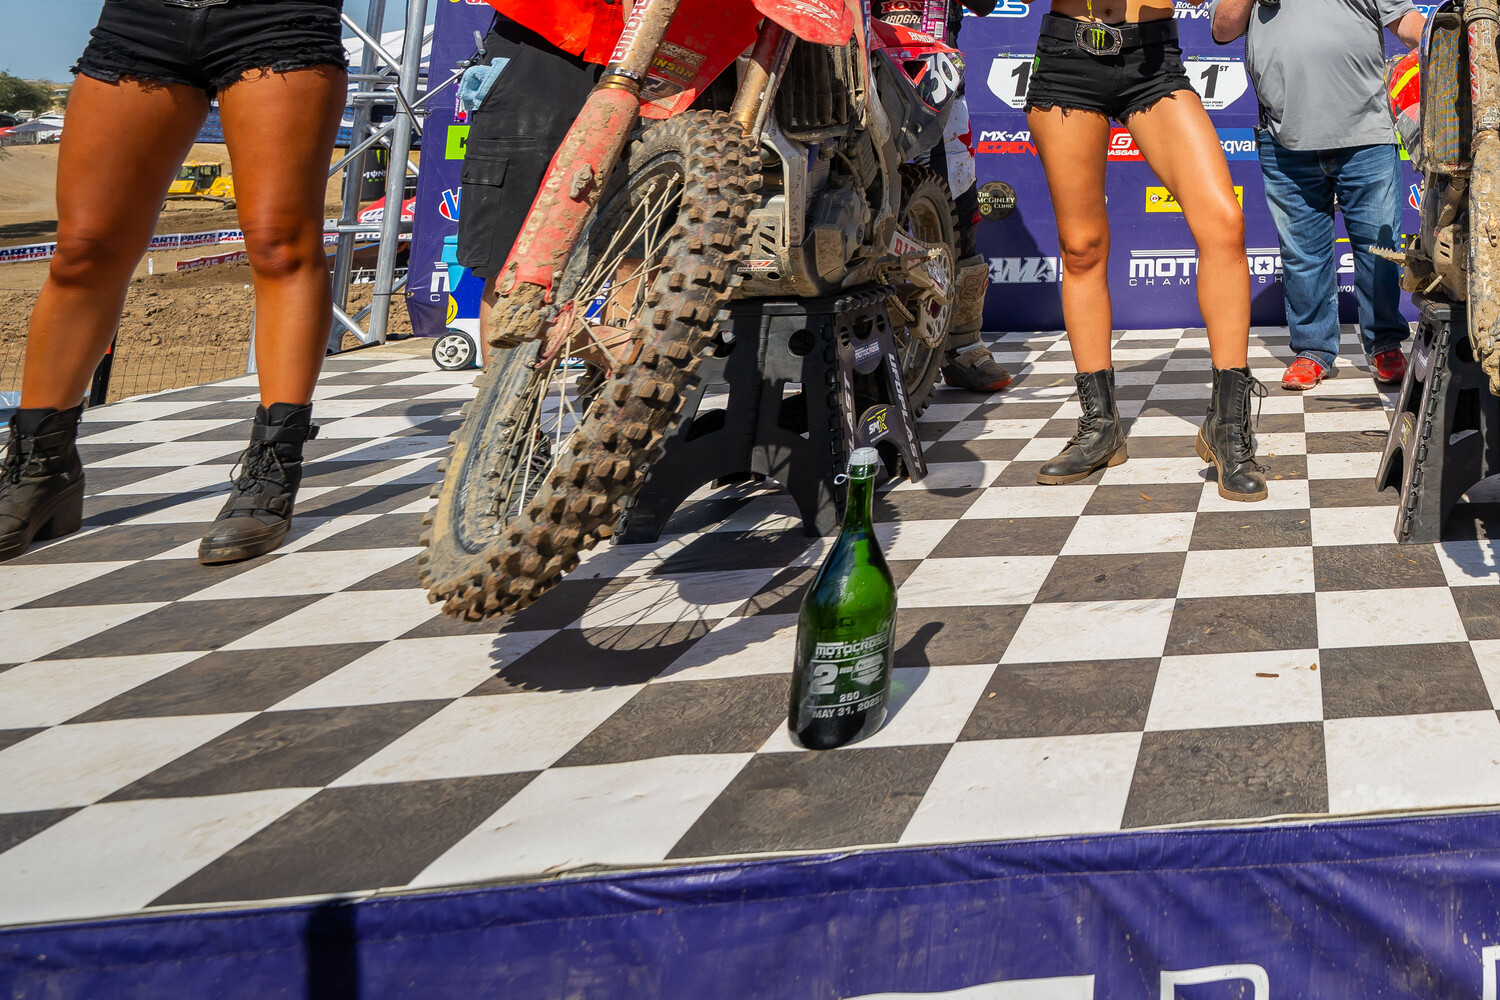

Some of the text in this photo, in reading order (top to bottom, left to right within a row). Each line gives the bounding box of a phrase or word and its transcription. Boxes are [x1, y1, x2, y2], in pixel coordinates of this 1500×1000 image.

[907, 31, 936, 44] HONDA
[925, 52, 961, 104] 30
[1011, 61, 1032, 97] 1
[152, 235, 180, 244] ARTS
[181, 232, 216, 242] PARTS
[810, 663, 839, 695] 2
[839, 690, 860, 703] 250
[812, 707, 836, 719] MAY
